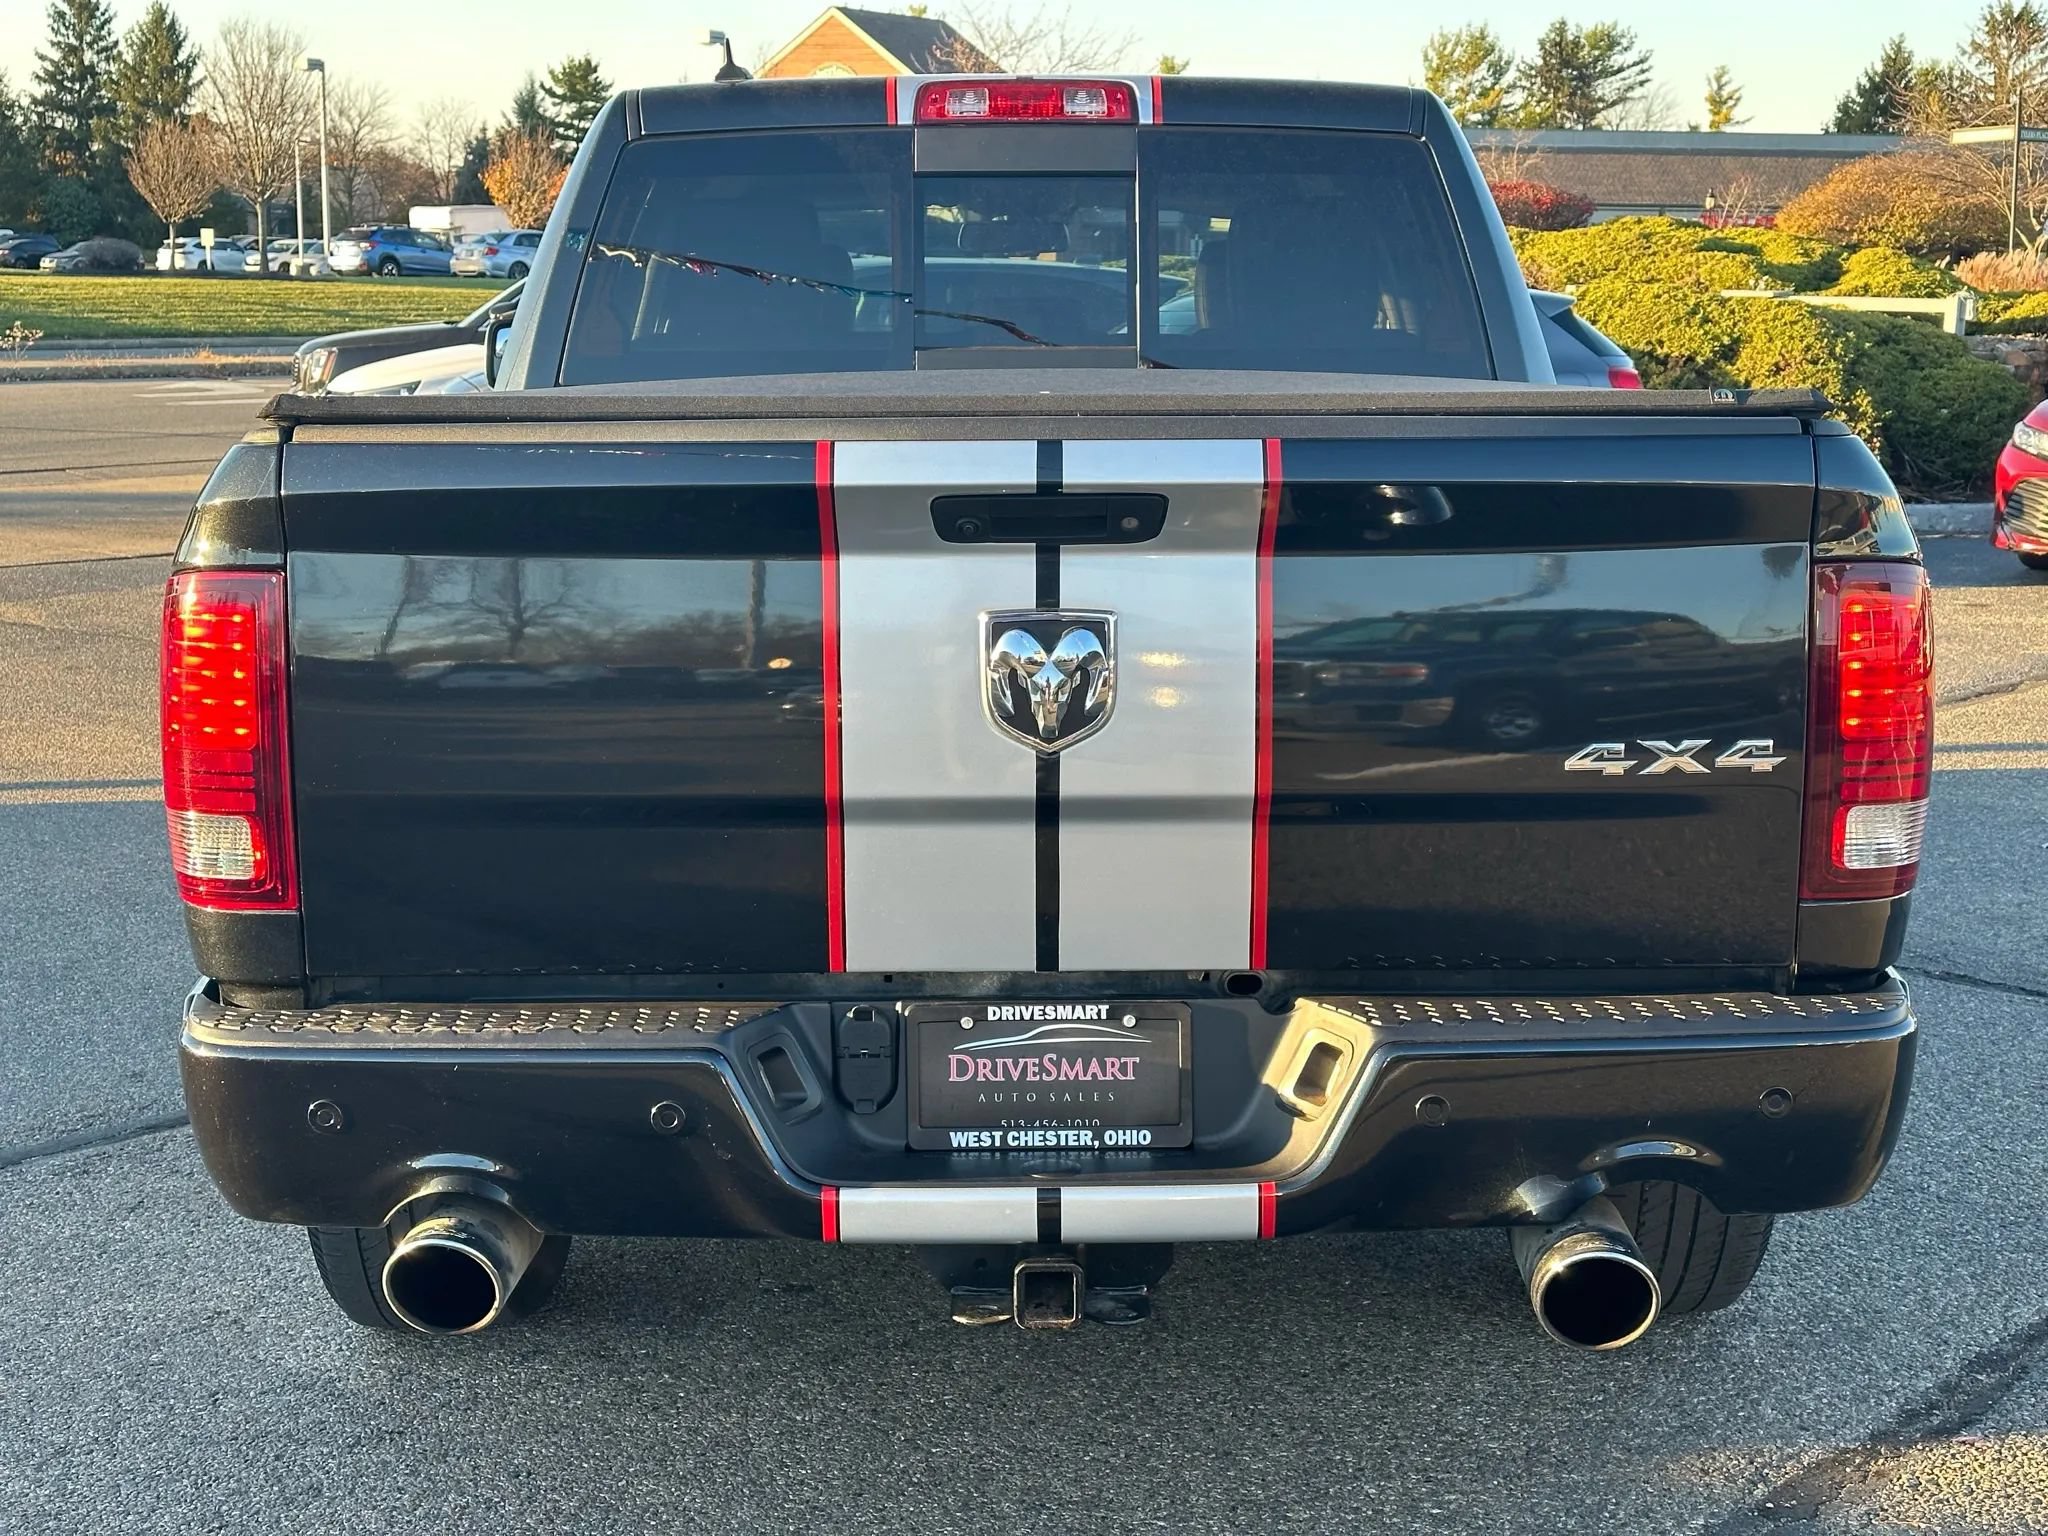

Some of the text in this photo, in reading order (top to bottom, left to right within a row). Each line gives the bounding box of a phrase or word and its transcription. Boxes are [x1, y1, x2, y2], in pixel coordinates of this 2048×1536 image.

[1565, 739, 1787, 776] 4X4
[987, 1005, 1109, 1021] DRIVESMART
[978, 1091, 1114, 1102] AUTO SALES
[950, 1129, 1151, 1149] WEST CHESTER, OHIO
